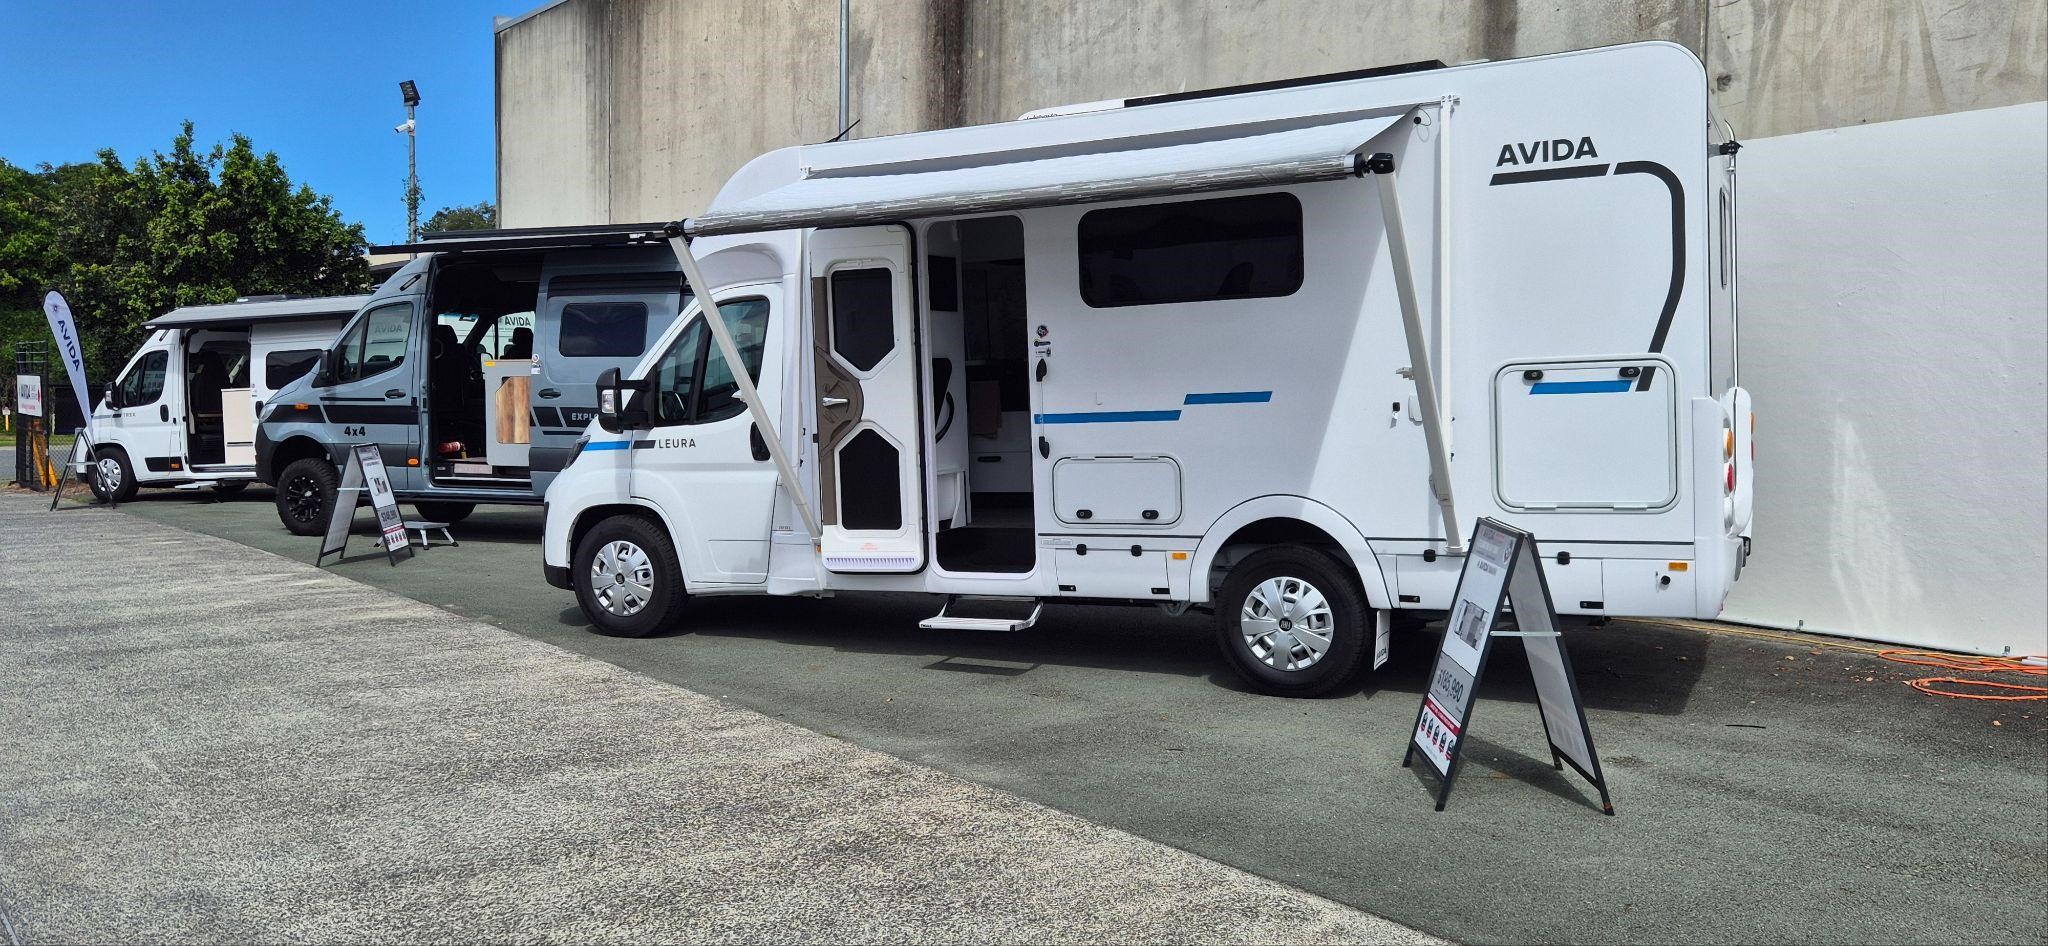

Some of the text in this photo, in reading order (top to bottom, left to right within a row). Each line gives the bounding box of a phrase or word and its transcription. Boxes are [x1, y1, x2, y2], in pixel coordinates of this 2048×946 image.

[1496, 136, 1598, 167] AVIDA
[58, 320, 80, 371] AVIDA
[344, 426, 366, 436] 4x4
[659, 438, 697, 449] LEURA
